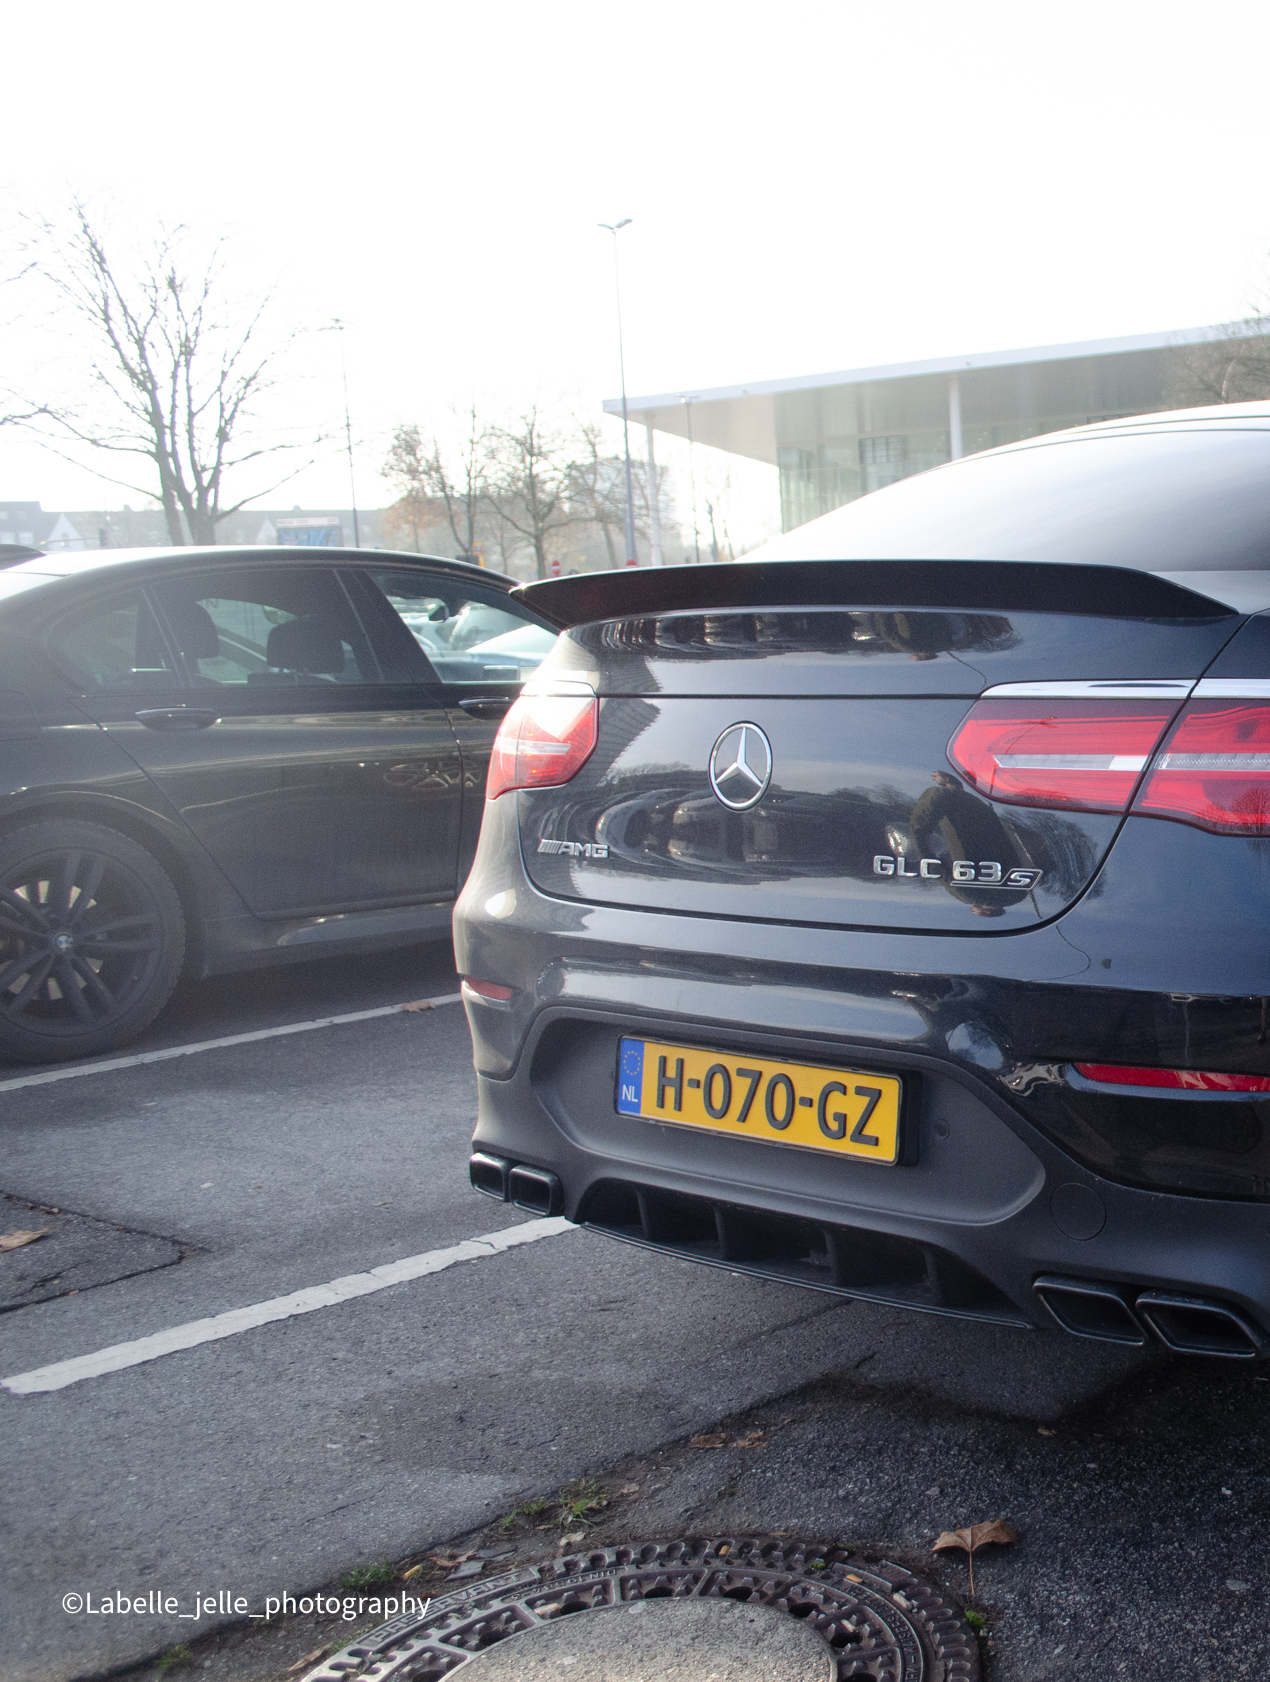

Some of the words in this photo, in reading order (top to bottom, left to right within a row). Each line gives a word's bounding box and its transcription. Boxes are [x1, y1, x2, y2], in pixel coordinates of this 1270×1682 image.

[557, 841, 609, 858] AMG
[873, 855, 942, 879] GLC
[622, 1084, 639, 1102] NL
[656, 1055, 882, 1147] H-070-GZ
